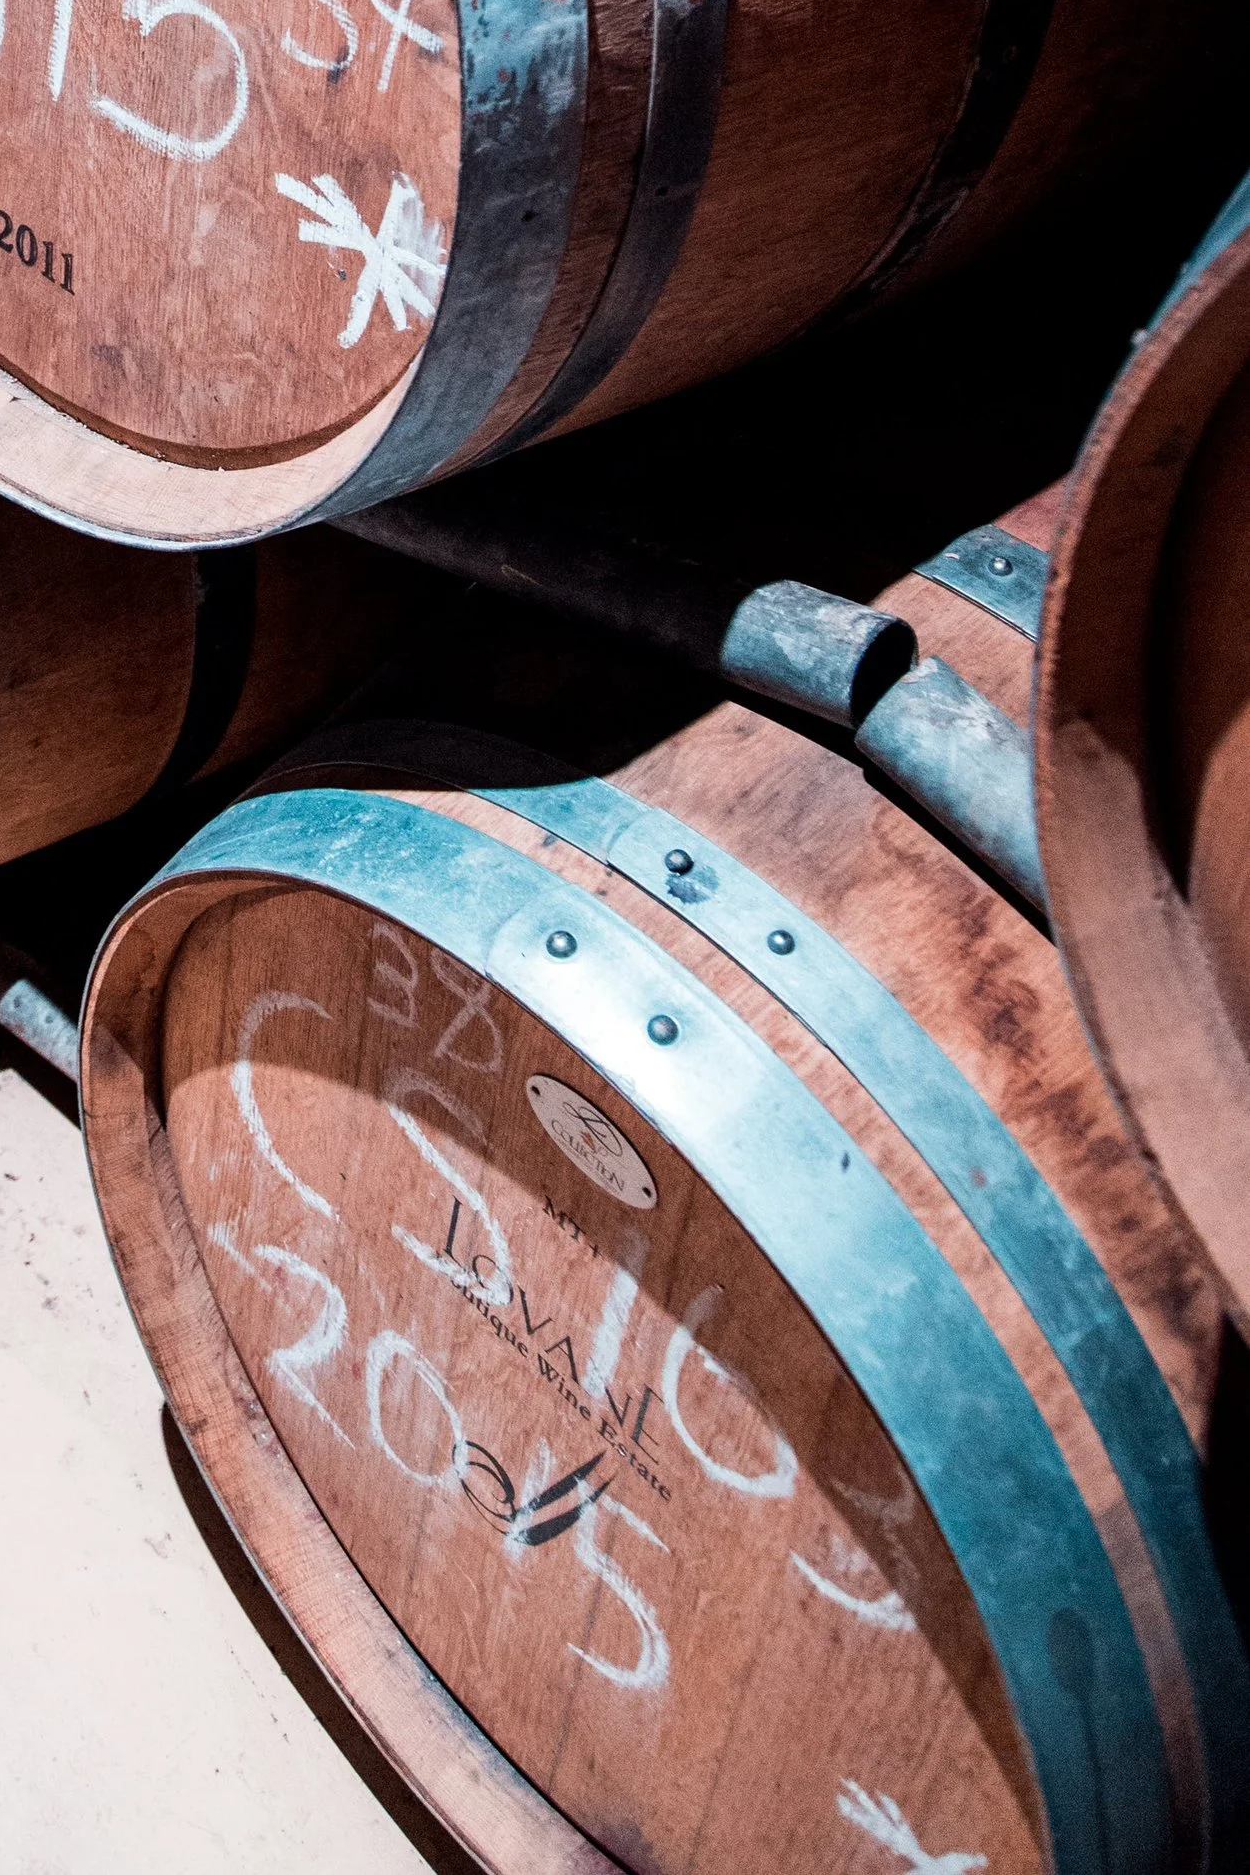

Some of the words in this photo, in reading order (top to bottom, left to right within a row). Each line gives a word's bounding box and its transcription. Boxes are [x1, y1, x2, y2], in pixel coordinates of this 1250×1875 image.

[235, 1235, 673, 1695] 2015
[537, 1353, 592, 1422] Wine
[598, 1419, 673, 1503] Estate
